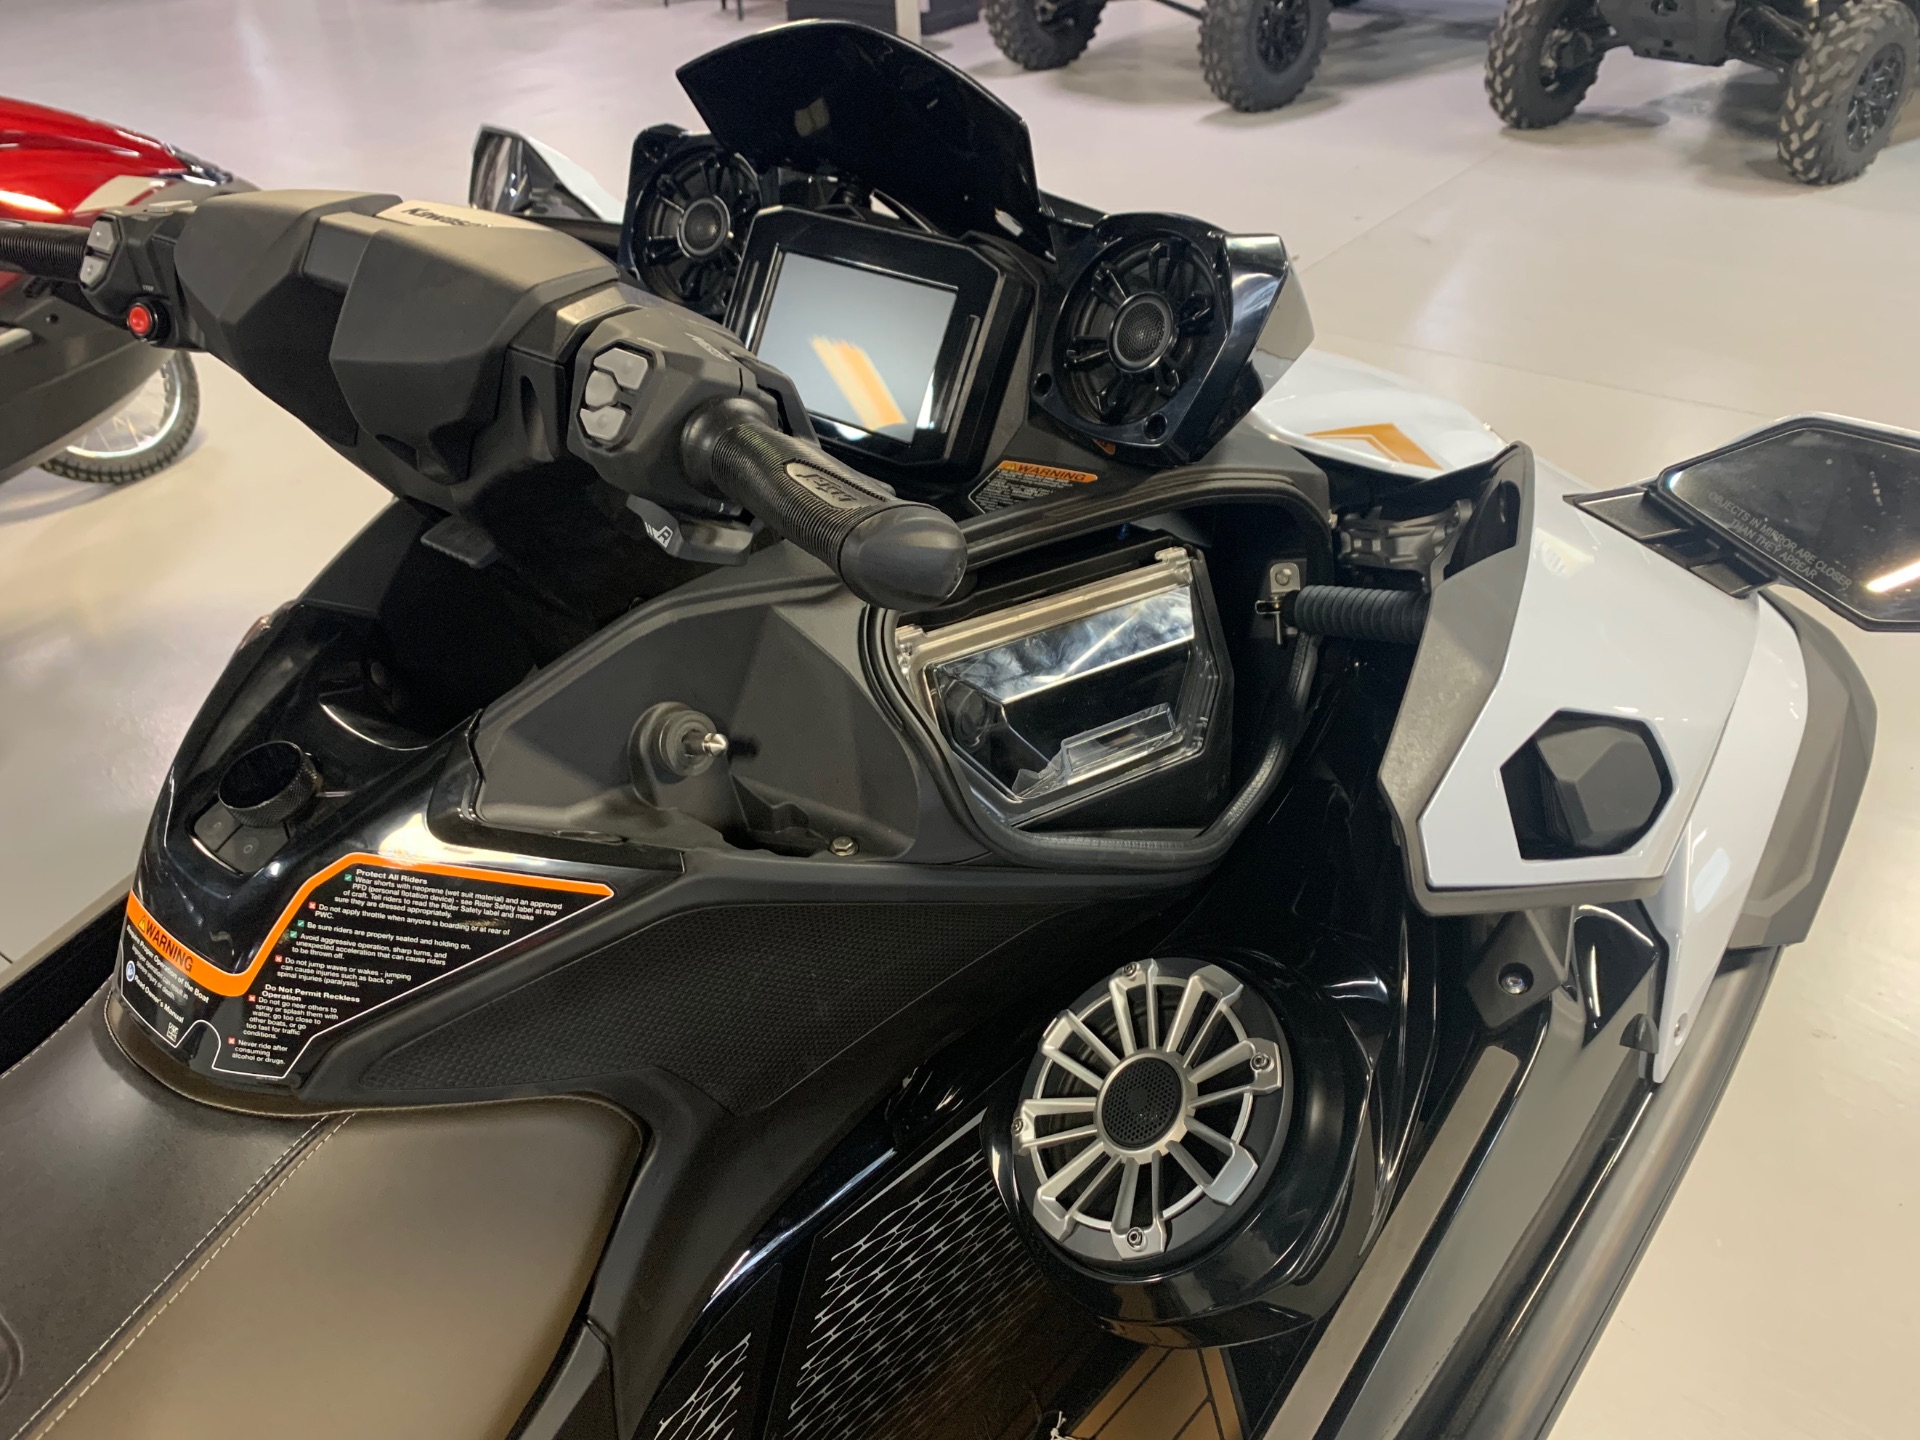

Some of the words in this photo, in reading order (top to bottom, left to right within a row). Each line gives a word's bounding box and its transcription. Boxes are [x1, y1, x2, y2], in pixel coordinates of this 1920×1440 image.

[1020, 464, 1086, 481] WARNING
[1708, 491, 1750, 522] OBJECTS
[1749, 518, 1762, 528] IN
[1760, 524, 1797, 552] MIRROR
[1795, 548, 1817, 564] ARE
[1815, 560, 1852, 588] CLOSER
[1731, 518, 1757, 539] THAN
[1756, 534, 1782, 554] THEY
[1779, 552, 1818, 580] APPEAR
[356, 868, 386, 879] Protect
[388, 872, 399, 881] All
[400, 874, 428, 885] Riders
[352, 883, 367, 891] PFD
[368, 885, 400, 896] (personal
[401, 889, 428, 900] flotation
[430, 893, 454, 905] device)
[474, 900, 492, 908] Rider
[494, 902, 516, 913] Safety
[517, 905, 534, 914] label
[355, 875, 373, 884] Wear
[373, 878, 395, 888] shorts
[396, 882, 411, 890] with
[412, 885, 444, 894] neoprene
[445, 888, 460, 896] (wet
[474, 893, 504, 904] material)
[530, 900, 562, 910] approved
[314, 910, 334, 919] PWC.
[334, 896, 350, 904] sure
[350, 897, 366, 907] they
[378, 901, 406, 912] dressed
[406, 906, 452, 919] appropriately.
[370, 893, 382, 901] Tell
[382, 895, 402, 904] riders
[403, 897, 410, 905] to
[428, 901, 440, 909] the
[441, 902, 459, 911] Rider
[460, 905, 482, 916] Safety
[483, 908, 500, 916] label
[515, 913, 534, 921] make
[318, 903, 329, 911] Do
[342, 908, 361, 917] apply
[362, 909, 386, 919] throttle
[387, 914, 405, 922] when
[406, 917, 431, 926] anyone
[439, 920, 469, 932] boarding
[306, 921, 317, 929] Be
[317, 924, 332, 932] sure
[333, 925, 353, 934] riders
[366, 931, 394, 941] properly
[395, 935, 418, 943] seated
[434, 938, 459, 950] holding
[146, 920, 194, 972] WARNING
[295, 940, 335, 951] unexpected
[335, 946, 376, 957] acceleration
[377, 950, 390, 959] that
[426, 957, 446, 966] riders
[300, 932, 320, 942] Avoid
[320, 937, 356, 947] aggressive
[357, 942, 391, 953] operation,
[392, 946, 412, 956] sharp
[413, 948, 432, 958] turns,
[309, 948, 332, 958] thrown
[333, 952, 345, 960] off.
[284, 957, 295, 965] Do
[308, 960, 325, 970] jump
[326, 964, 348, 972] waves
[357, 968, 379, 976] wakes
[384, 970, 412, 981] jumping
[295, 966, 315, 974] cause
[315, 968, 340, 978] injuries
[368, 975, 385, 984] back
[154, 954, 177, 979] Operation
[178, 976, 184, 984] of
[184, 981, 194, 992] the
[194, 988, 209, 1003] Boat
[276, 971, 297, 979] spinal
[298, 973, 322, 983] injuries
[324, 976, 360, 989] (paralysis).
[262, 990, 302, 1002] Operation
[264, 983, 277, 992] Do
[278, 985, 293, 994] Not
[294, 987, 322, 998] Permit
[323, 991, 360, 1003] Reckless
[164, 1004, 184, 1023] Manual
[255, 1004, 274, 1013] spray
[283, 1008, 305, 1016] splash
[306, 1010, 323, 1018] them
[258, 996, 268, 1004] Do
[291, 1002, 307, 1010] near
[307, 1004, 329, 1013] others
[330, 1006, 338, 1014] to
[248, 1016, 266, 1024] other
[267, 1018, 288, 1029] boats,
[252, 1011, 272, 1020] water,
[295, 1016, 313, 1024] close
[242, 1029, 278, 1040] conditions.
[246, 1022, 257, 1030] too
[258, 1024, 274, 1032] fast
[282, 1027, 301, 1036] traffic
[234, 1046, 271, 1058] consuming
[238, 1038, 258, 1048] Never
[258, 1042, 272, 1050] ride
[272, 1044, 288, 1052] after
[232, 1052, 256, 1061] alcohol
[264, 1056, 286, 1066] drugs.
